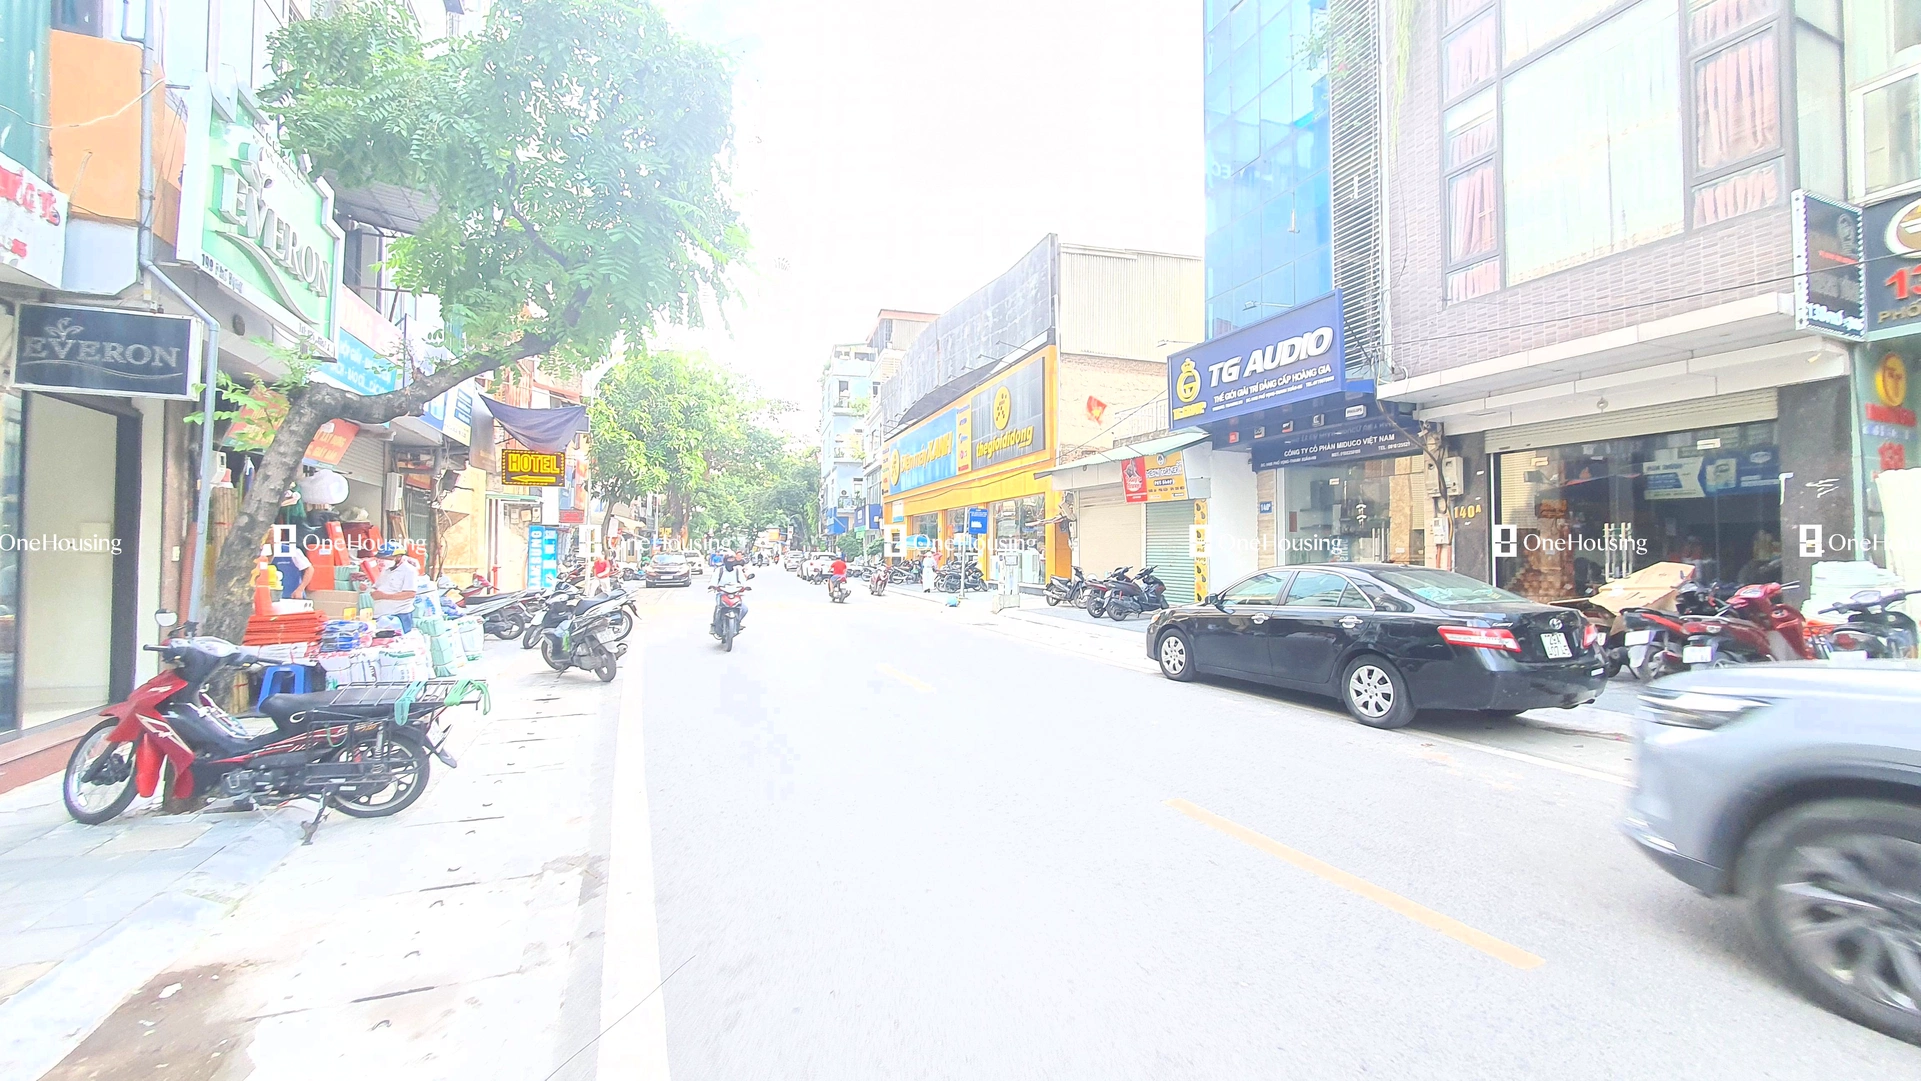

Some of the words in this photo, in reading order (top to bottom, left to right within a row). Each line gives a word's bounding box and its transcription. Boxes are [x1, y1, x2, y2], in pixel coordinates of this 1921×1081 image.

[219, 166, 331, 298] EVERON
[21, 336, 181, 368] EVERON
[1208, 355, 1243, 388] TG
[1243, 326, 1335, 378] AUDIO
[1300, 447, 1309, 455] TY
[1336, 438, 1362, 449] MIDUCO
[1379, 433, 1395, 442] NAM
[508, 453, 560, 474] HOTEL
